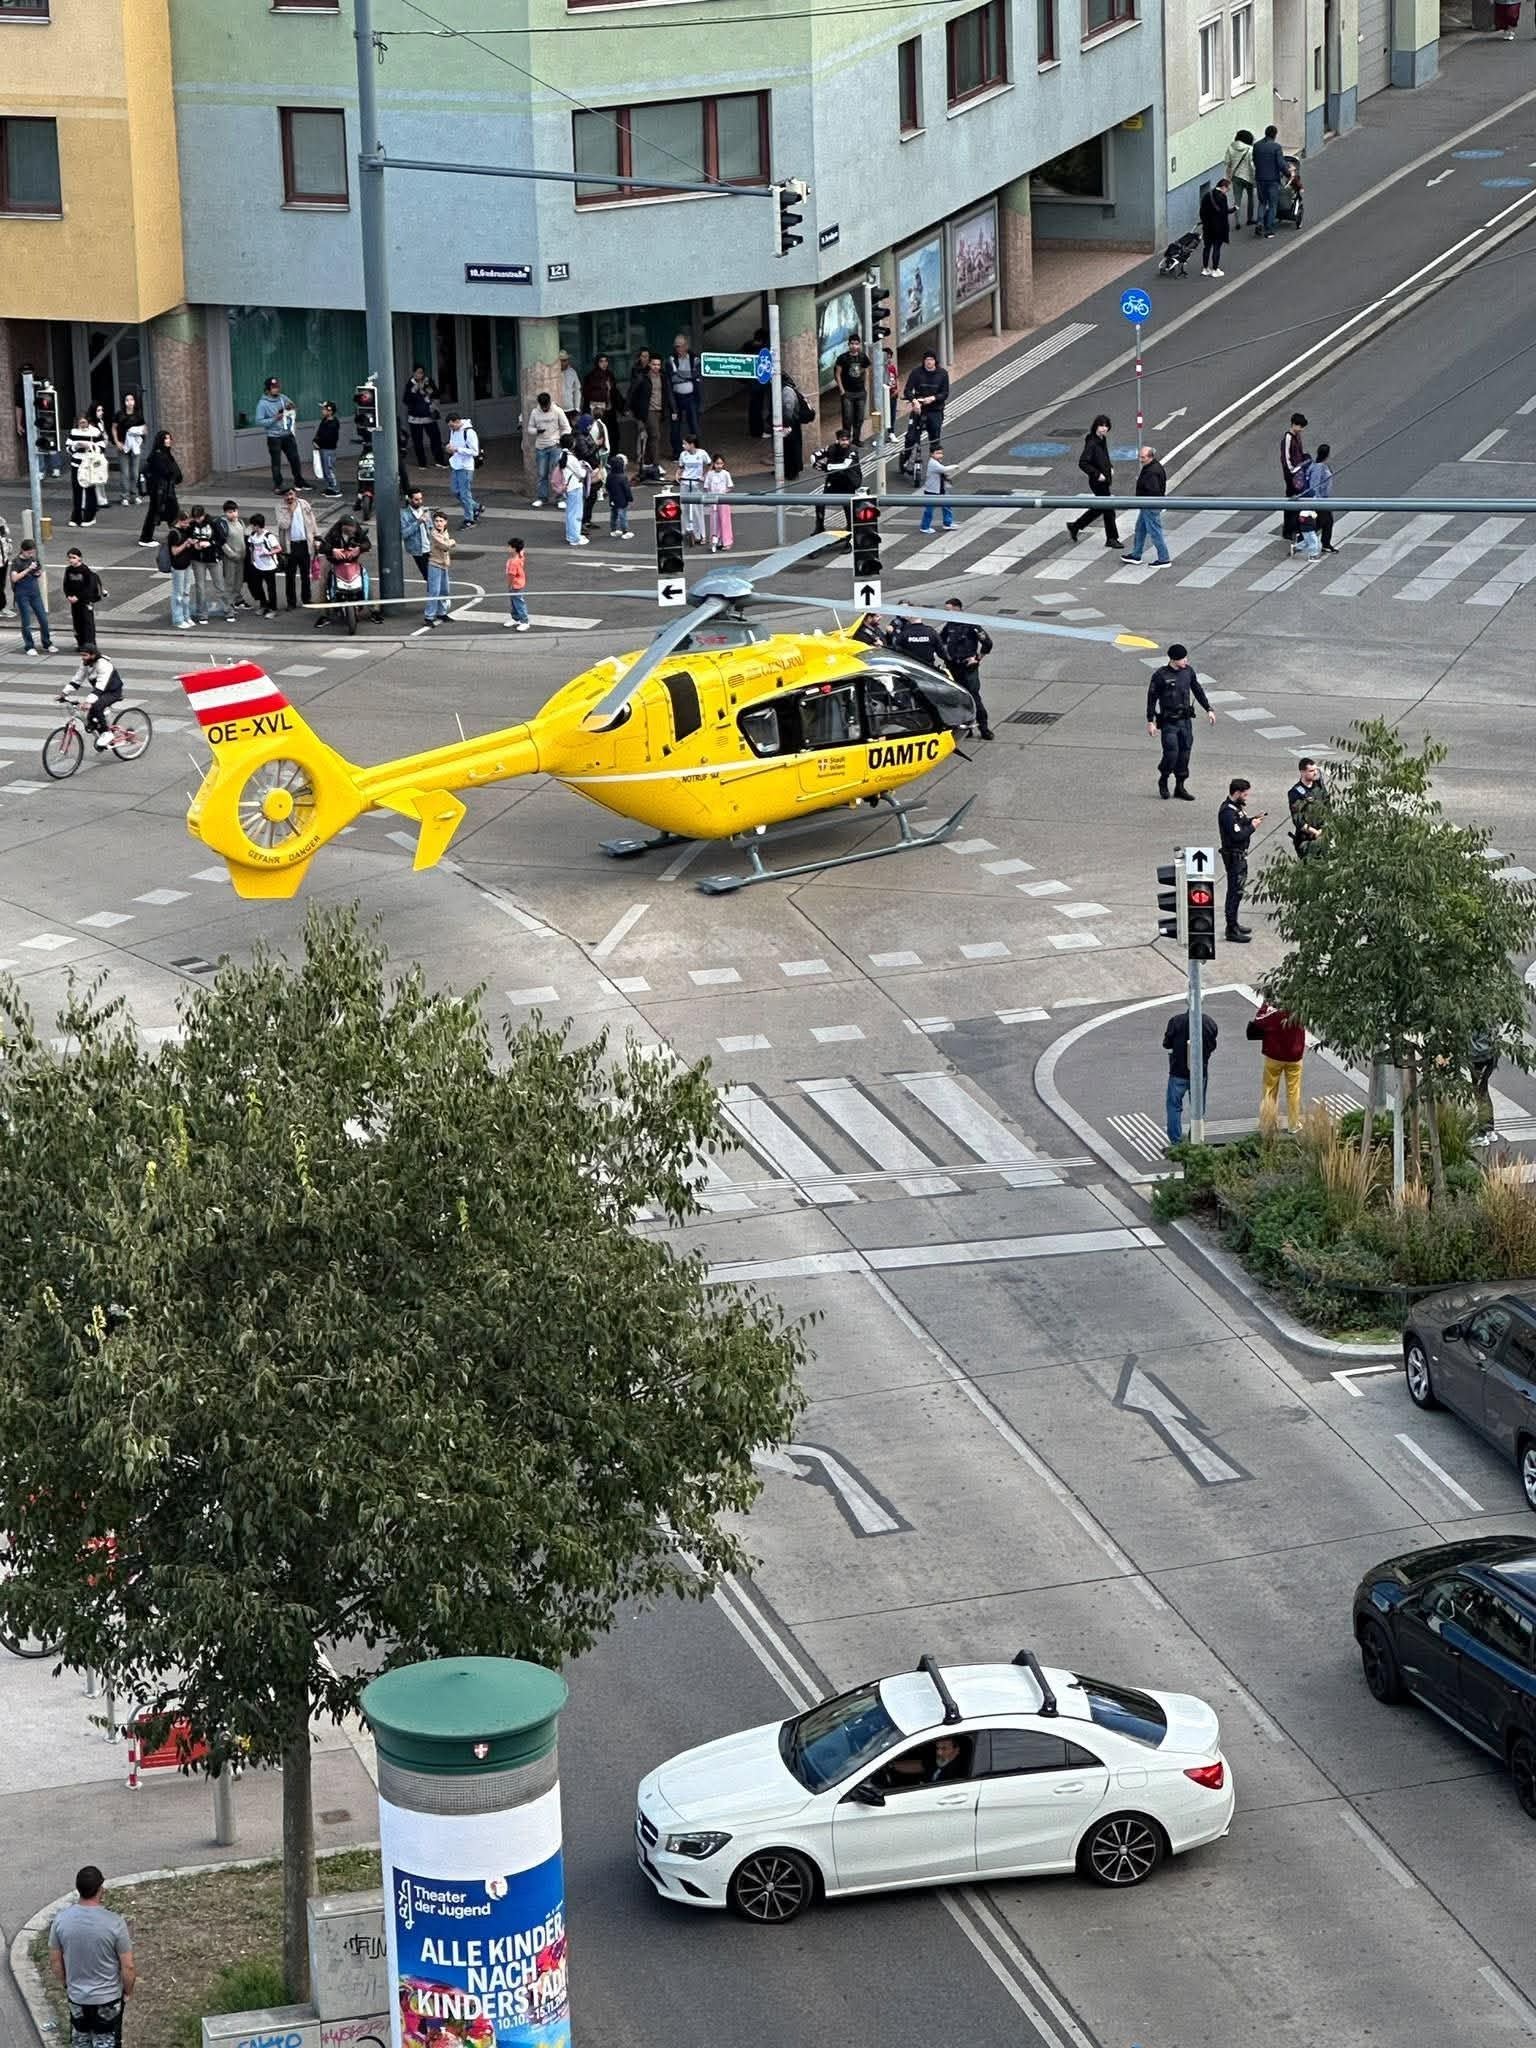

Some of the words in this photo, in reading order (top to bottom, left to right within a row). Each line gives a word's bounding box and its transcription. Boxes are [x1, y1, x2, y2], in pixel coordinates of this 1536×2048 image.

[550, 264, 567, 276] 121
[207, 712, 293, 745] OE-XVL
[681, 773, 708, 783] NOTRUF
[248, 849, 280, 864] GEFAHR
[288, 834, 321, 862] DANGER
[413, 1885, 467, 1903] Theater
[414, 1899, 436, 1914] der
[437, 1901, 491, 1919] Jugend
[420, 1937, 482, 1967] ALLE
[488, 1911, 565, 1966] KINDER
[468, 1955, 538, 1993] NACH
